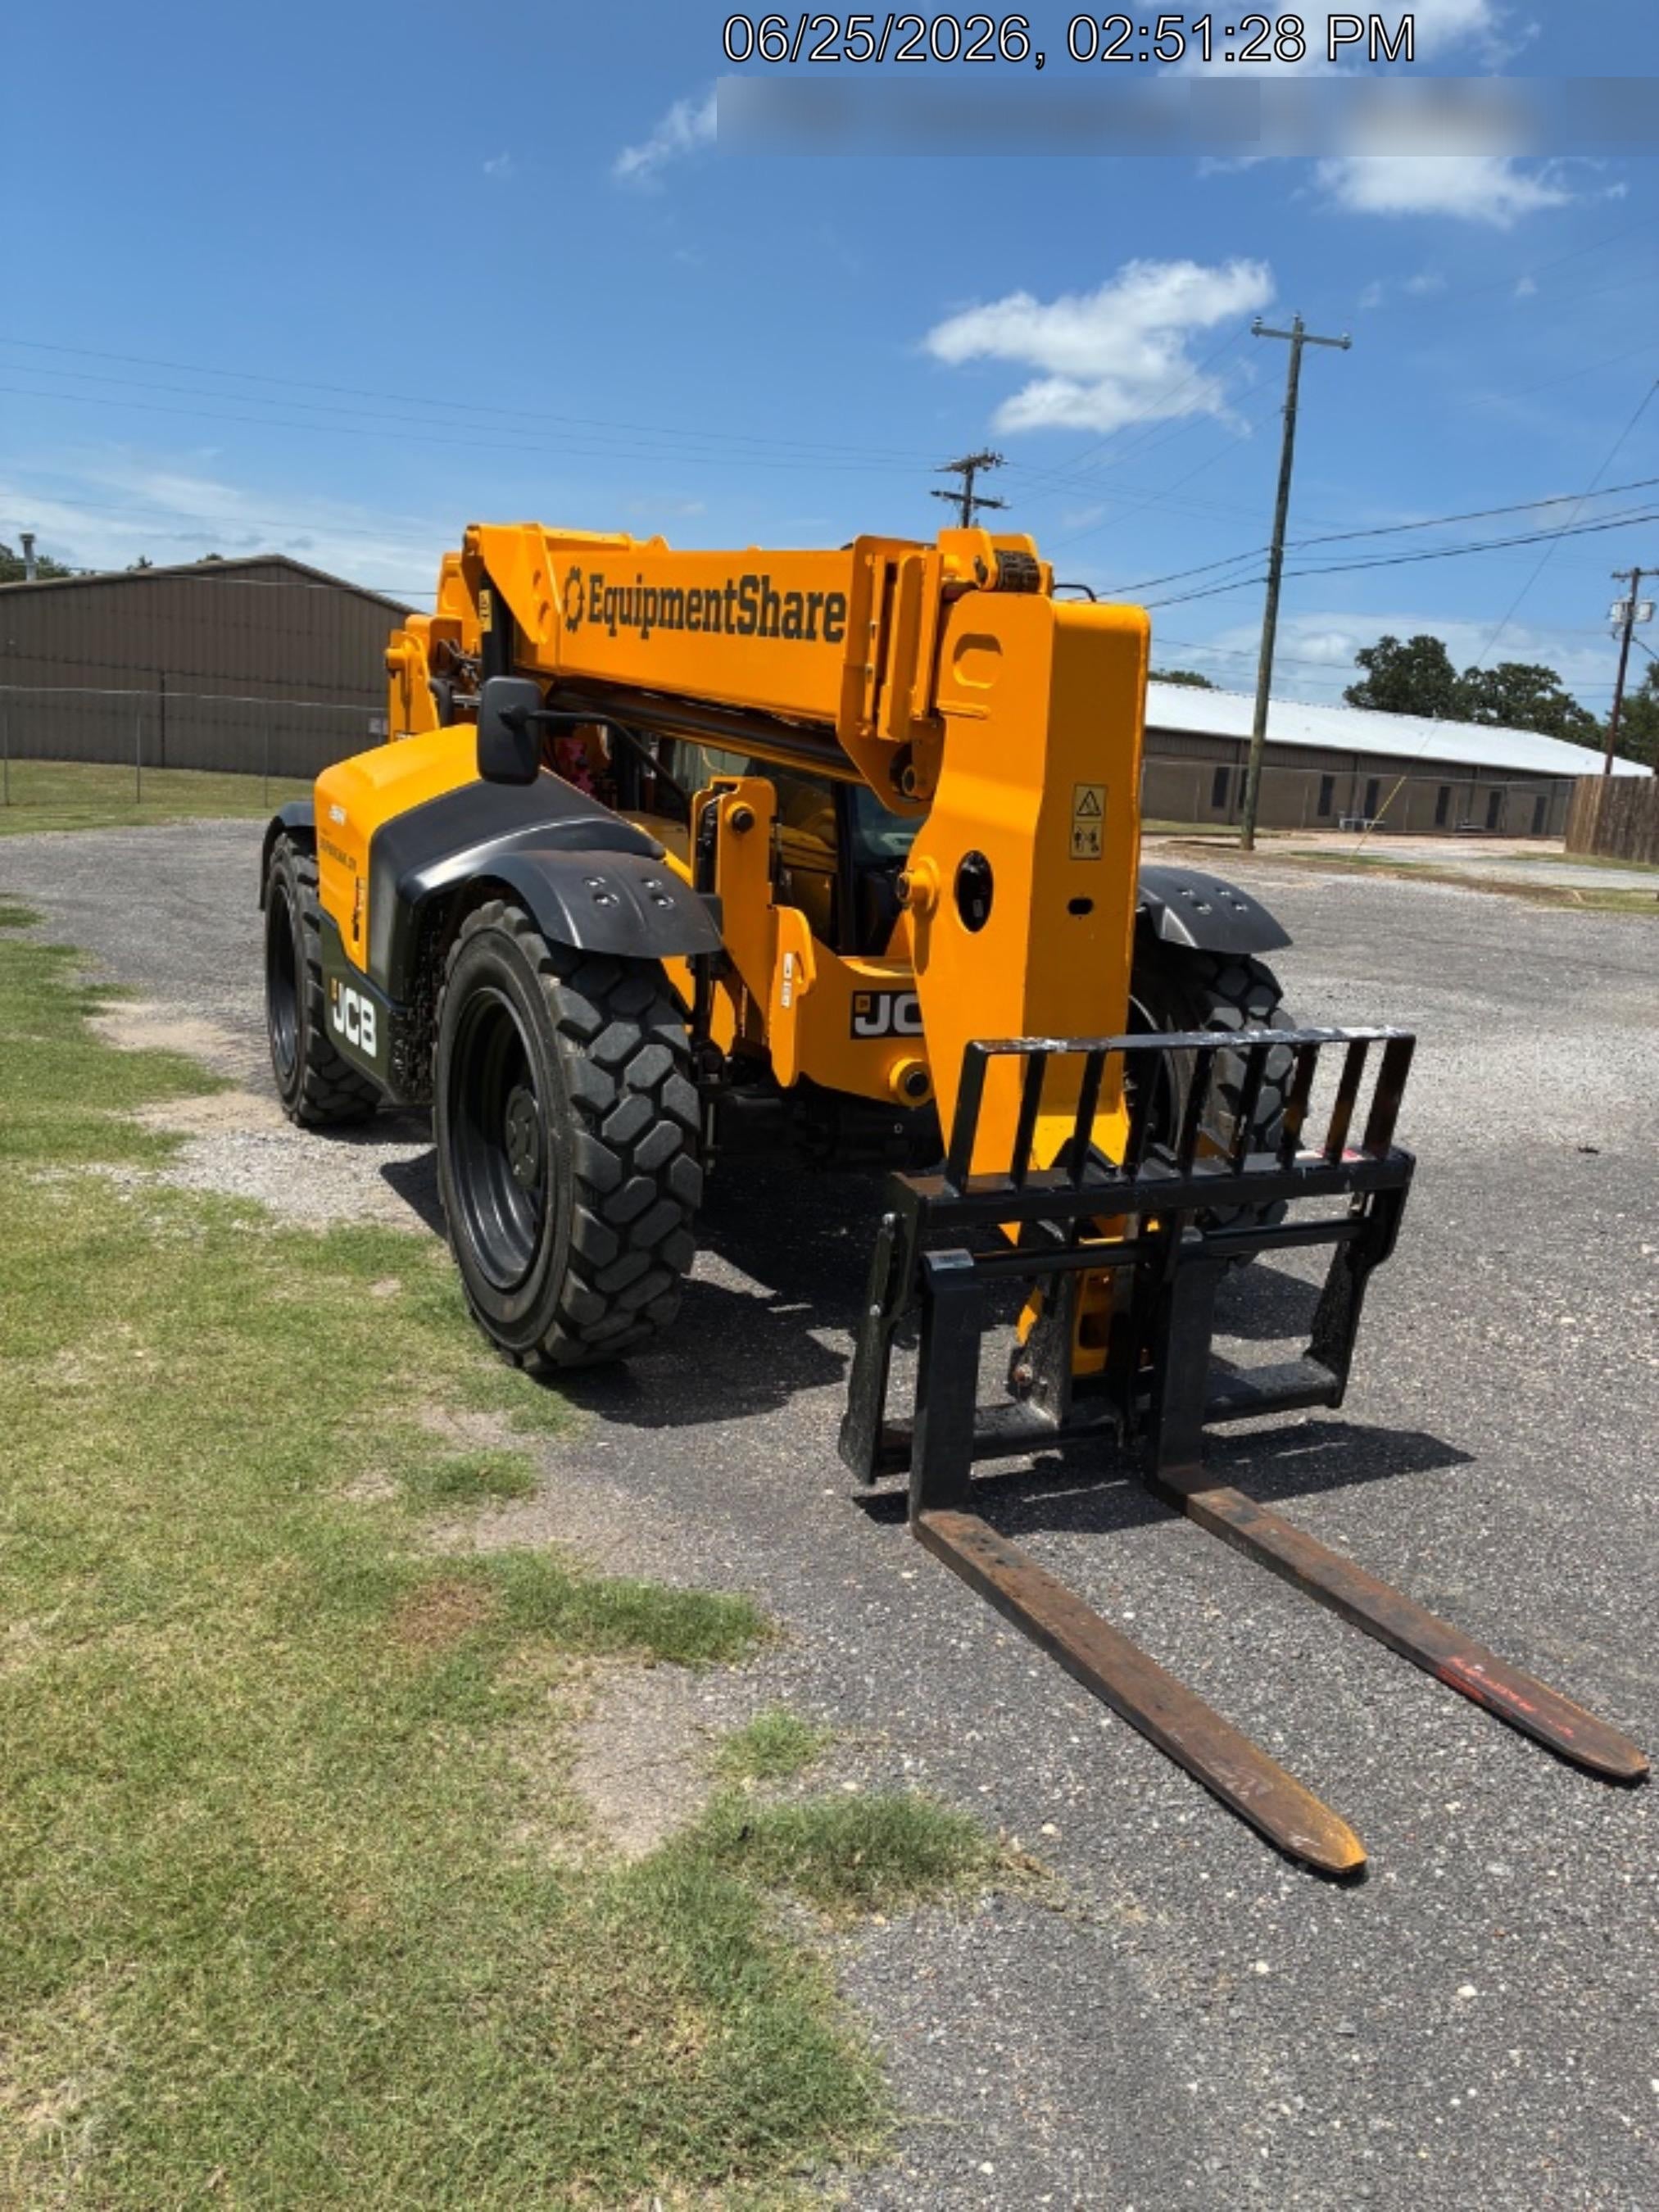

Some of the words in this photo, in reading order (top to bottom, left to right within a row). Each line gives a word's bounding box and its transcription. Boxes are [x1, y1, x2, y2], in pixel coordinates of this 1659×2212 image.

[587, 573, 846, 642] EquipmentShare
[333, 981, 377, 1058] JCB
[854, 994, 923, 1035] JC
